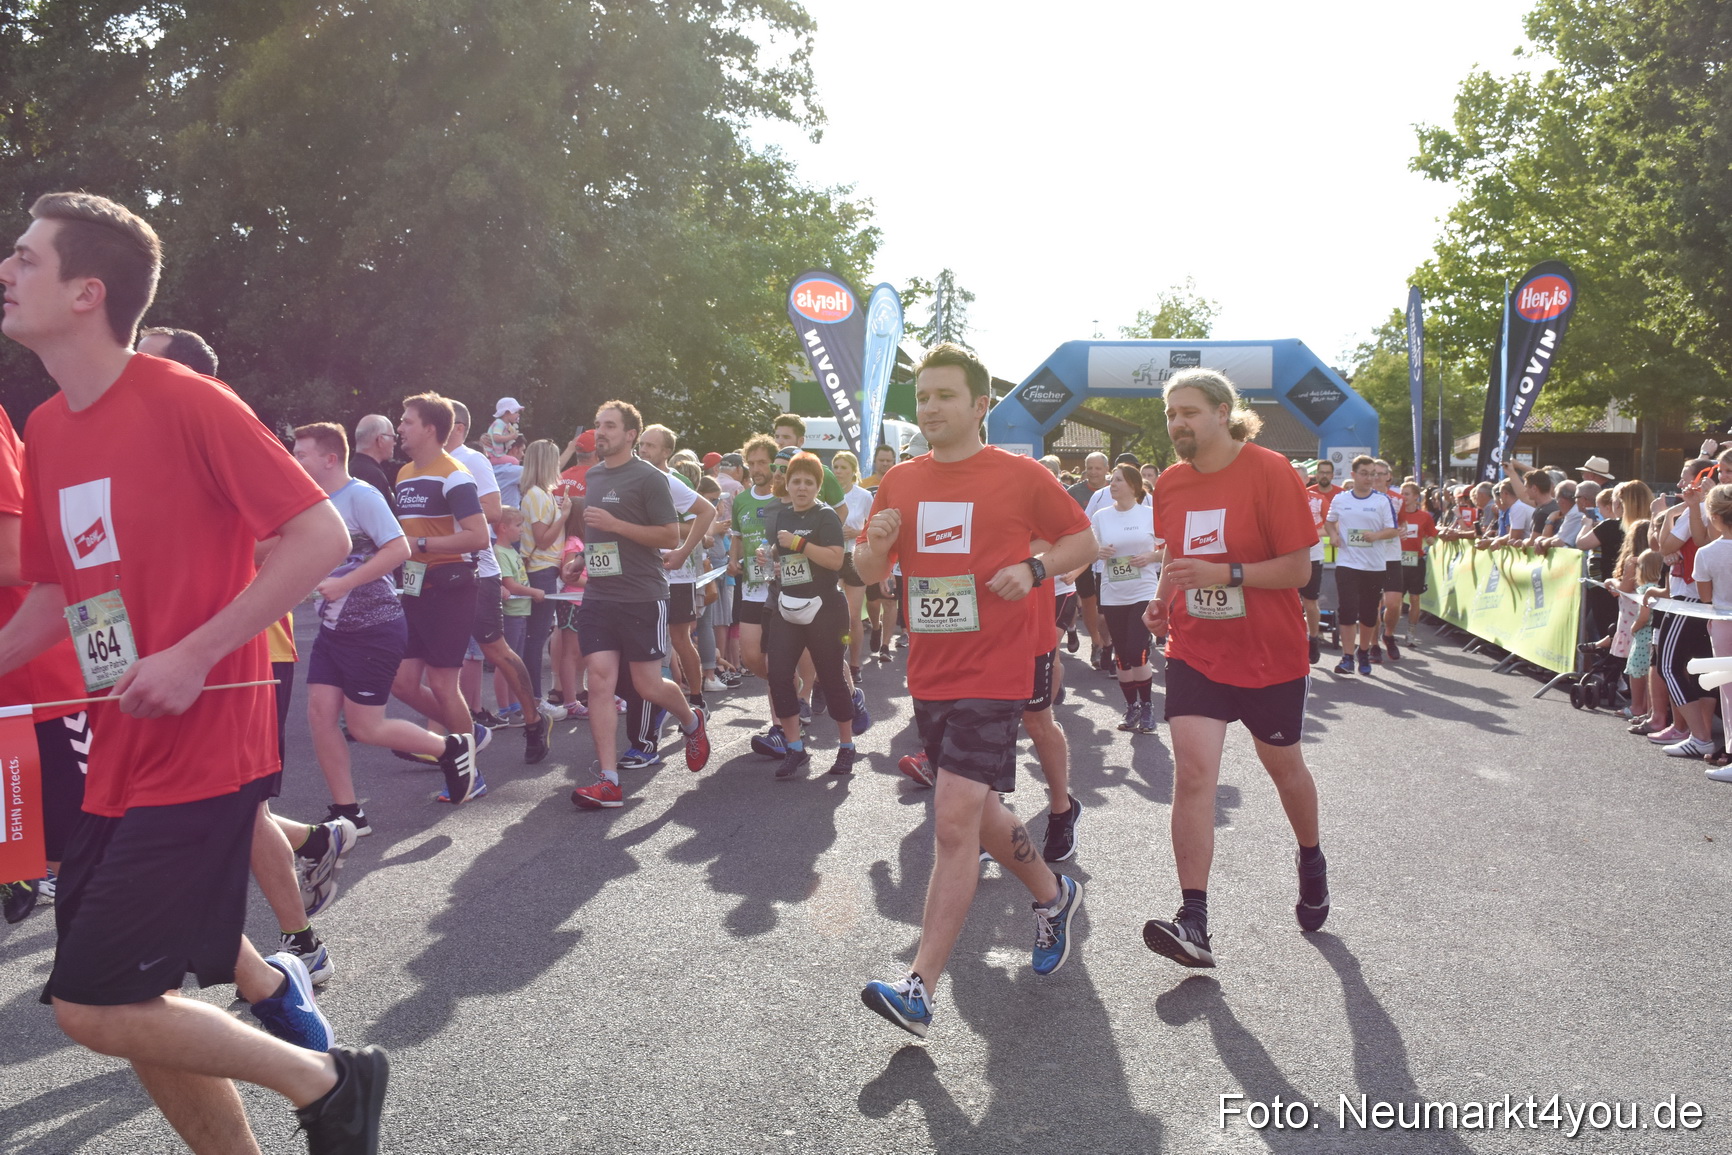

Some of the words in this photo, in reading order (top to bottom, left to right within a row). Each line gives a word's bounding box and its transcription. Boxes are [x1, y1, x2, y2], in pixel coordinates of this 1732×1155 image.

[1521, 286, 1567, 311] Hervis
[1029, 391, 1065, 399] Fischer
[400, 494, 428, 504] Fischer
[935, 531, 952, 541] DEHN
[590, 555, 610, 567] 430
[1113, 564, 1132, 575] 654
[1194, 588, 1228, 607] 479
[921, 597, 960, 618] 522
[88, 626, 121, 664] 464
[11, 809, 23, 840] DEHN
